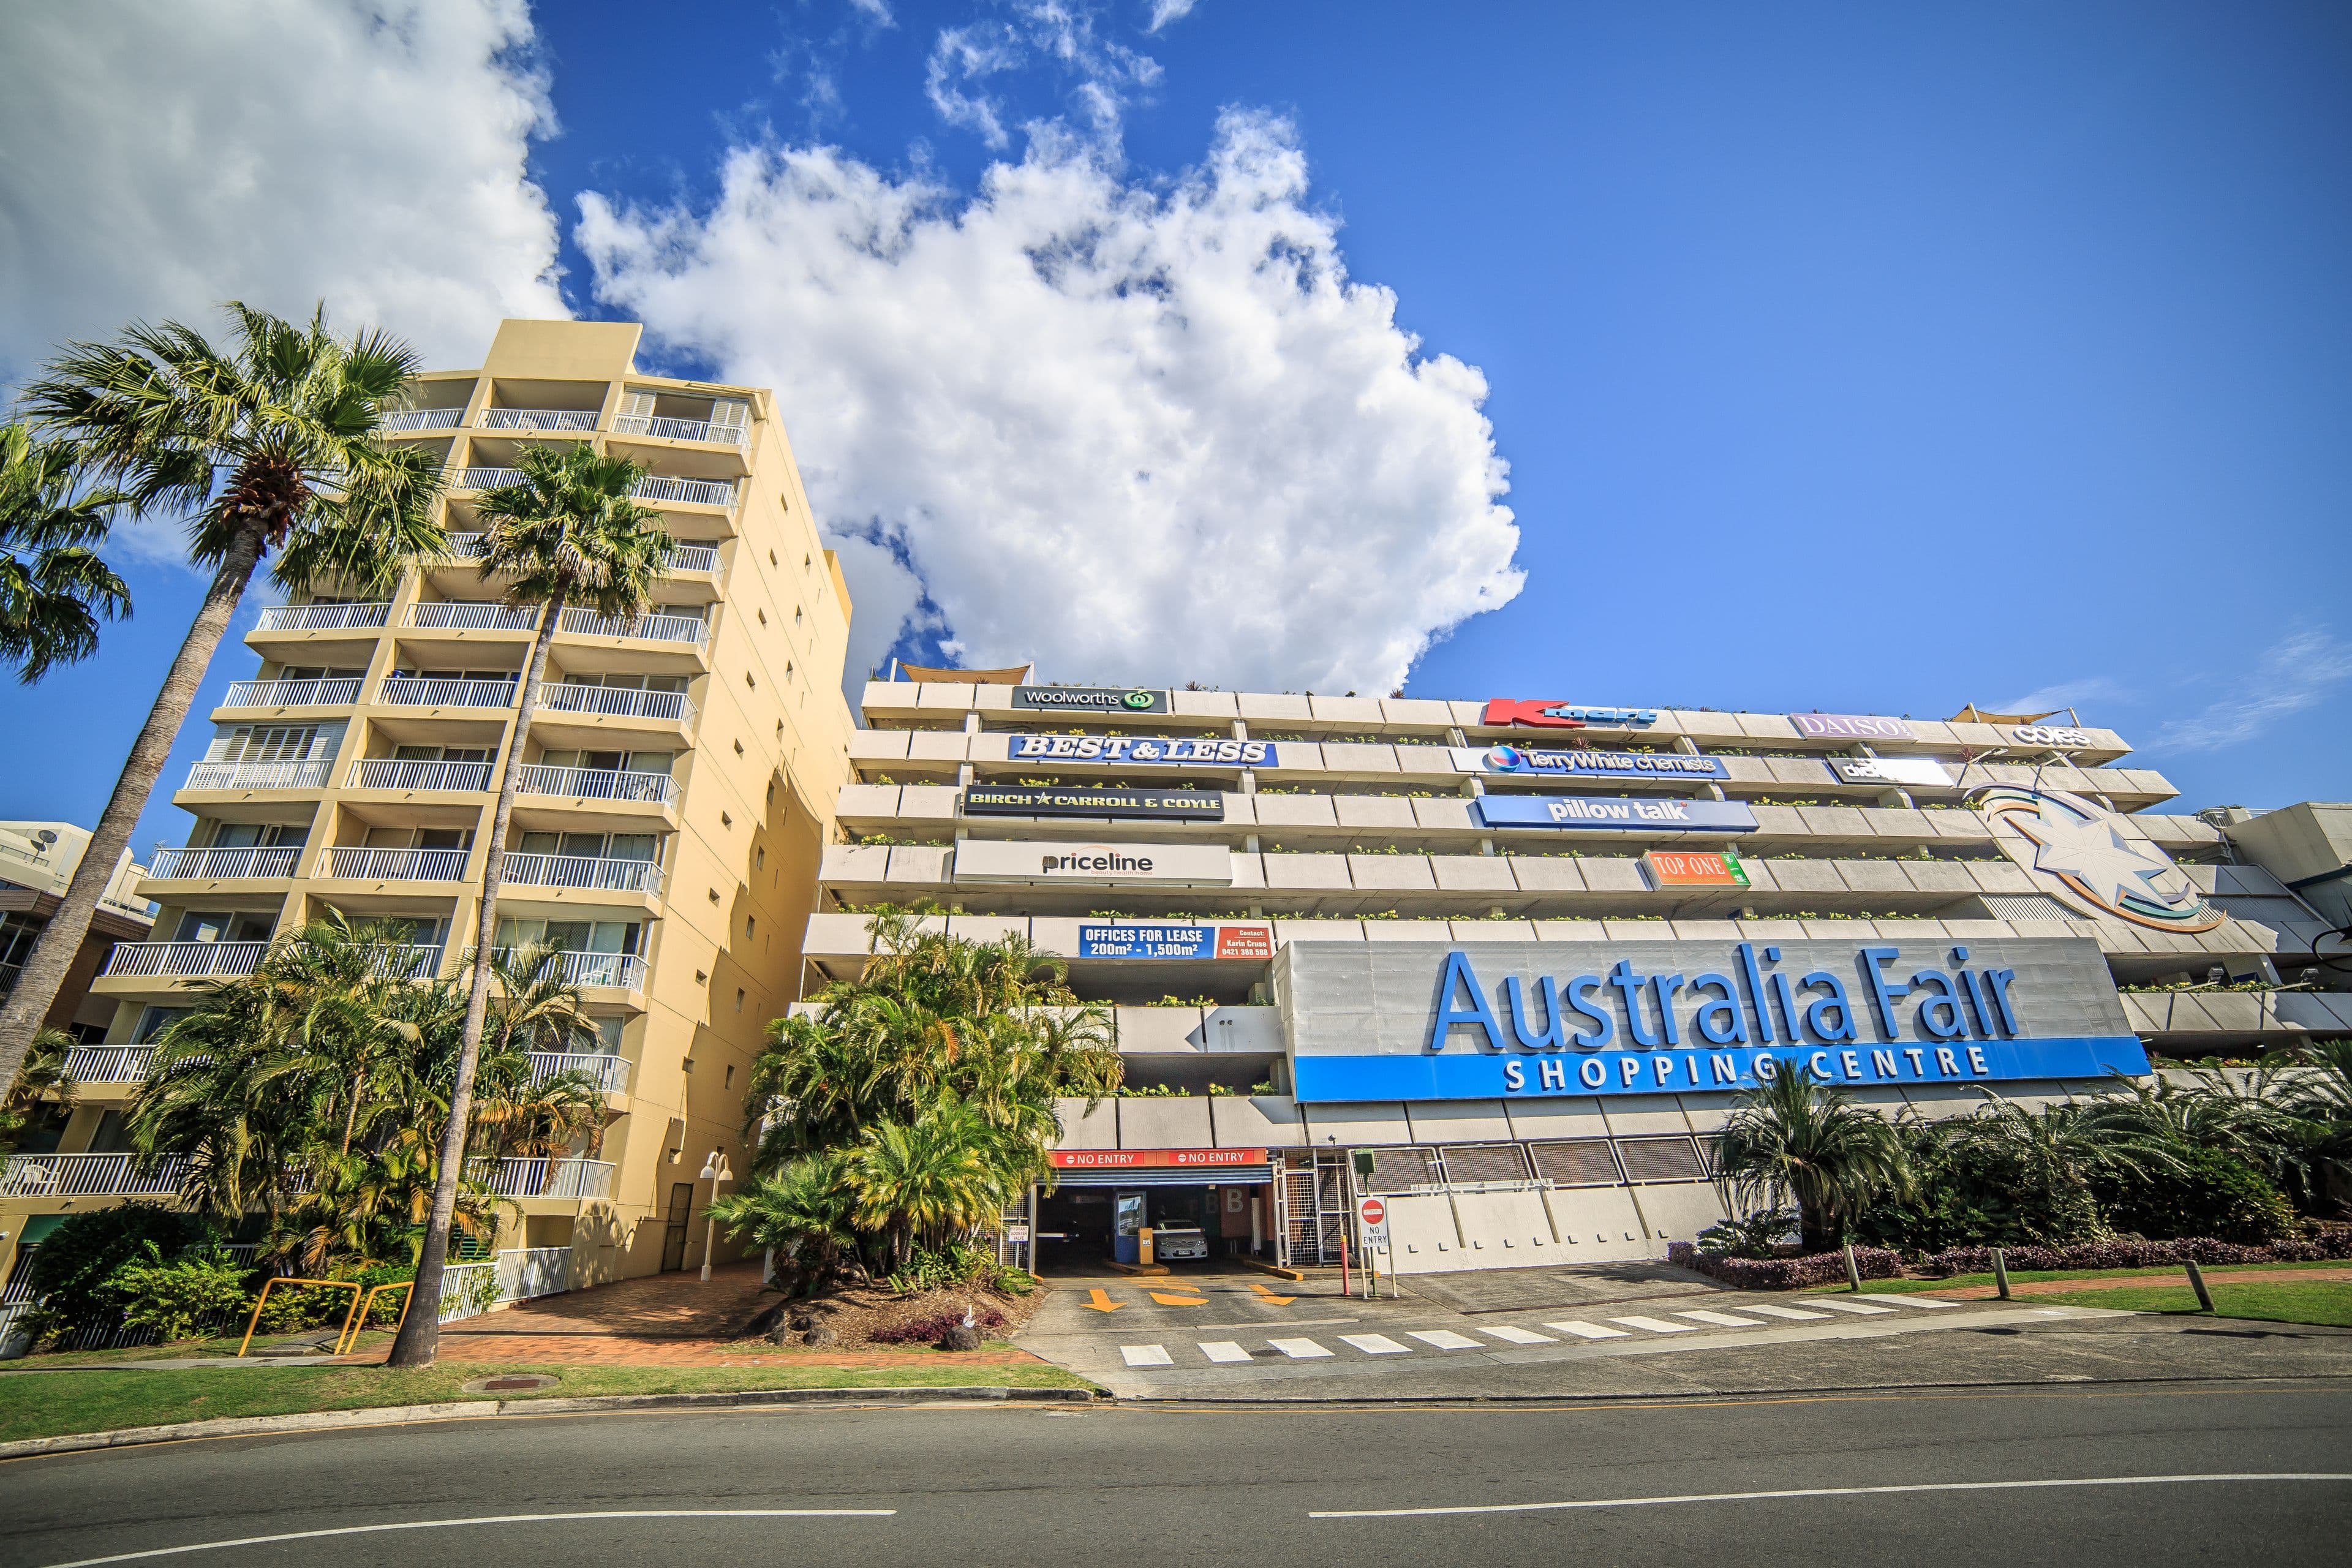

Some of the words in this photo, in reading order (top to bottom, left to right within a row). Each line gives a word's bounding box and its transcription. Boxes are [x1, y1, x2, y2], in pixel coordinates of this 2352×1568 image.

[1026, 690, 1119, 704] Woolworths
[1484, 698, 1657, 728] Kmart
[1797, 717, 1899, 736] DAISO
[2014, 726, 2091, 745] coles
[1017, 737, 1131, 760] BEST
[1132, 742, 1160, 760] &
[1162, 741, 1267, 763] LESS
[1523, 751, 1634, 771] TerryWhite
[1635, 756, 1716, 772] chemists
[970, 793, 1031, 804] BIRCH
[1054, 796, 1140, 807] CARROLL
[1145, 799, 1158, 807] &
[1163, 799, 1221, 809] COYLE
[1547, 798, 1630, 822] pillow
[1633, 801, 1691, 820] talk
[1042, 852, 1153, 874] priceline
[1654, 857, 1686, 875] TOP
[1689, 857, 1725, 875] ONE
[1085, 929, 1136, 941] OFFICES
[1139, 929, 1163, 941] FOR
[1166, 929, 1203, 942] LEASE
[1430, 943, 1858, 1050] Australia
[1861, 947, 2019, 1039] Fair
[1505, 1052, 1778, 1090] SHOPPING
[1809, 1047, 1988, 1079] CENTRE
[1077, 1155, 1095, 1164] NO
[1098, 1154, 1135, 1164] ENTRY
[1188, 1153, 1206, 1163] NO
[1209, 1152, 1245, 1162] ENTRY
[1227, 1189, 1243, 1213] B
[1363, 1235, 1387, 1245] ENTRY
